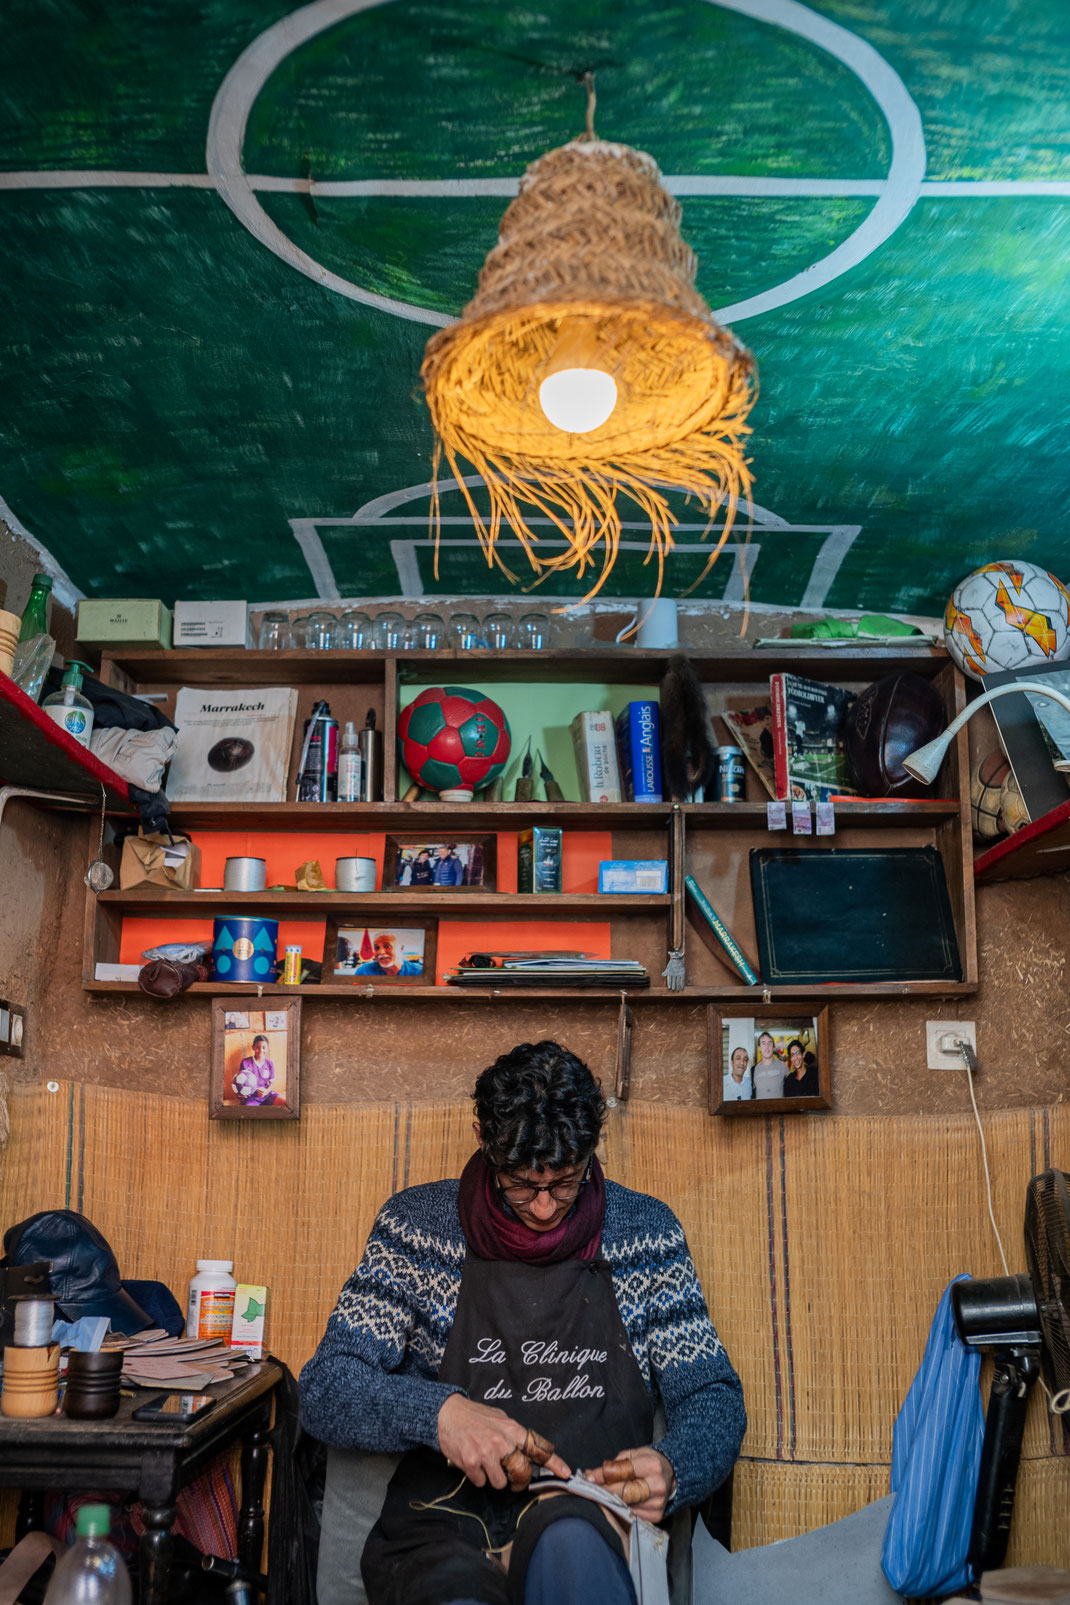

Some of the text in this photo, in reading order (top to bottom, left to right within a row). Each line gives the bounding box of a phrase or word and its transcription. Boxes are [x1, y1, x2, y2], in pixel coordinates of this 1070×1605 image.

[200, 702, 265, 713] Marrakech
[638, 705, 655, 746] Anglais
[645, 754, 655, 792] LAROUSSE
[712, 919, 745, 968] MARRAKESH
[469, 1338, 608, 1370] La Clinique
[483, 1374, 606, 1402] du Ballon
